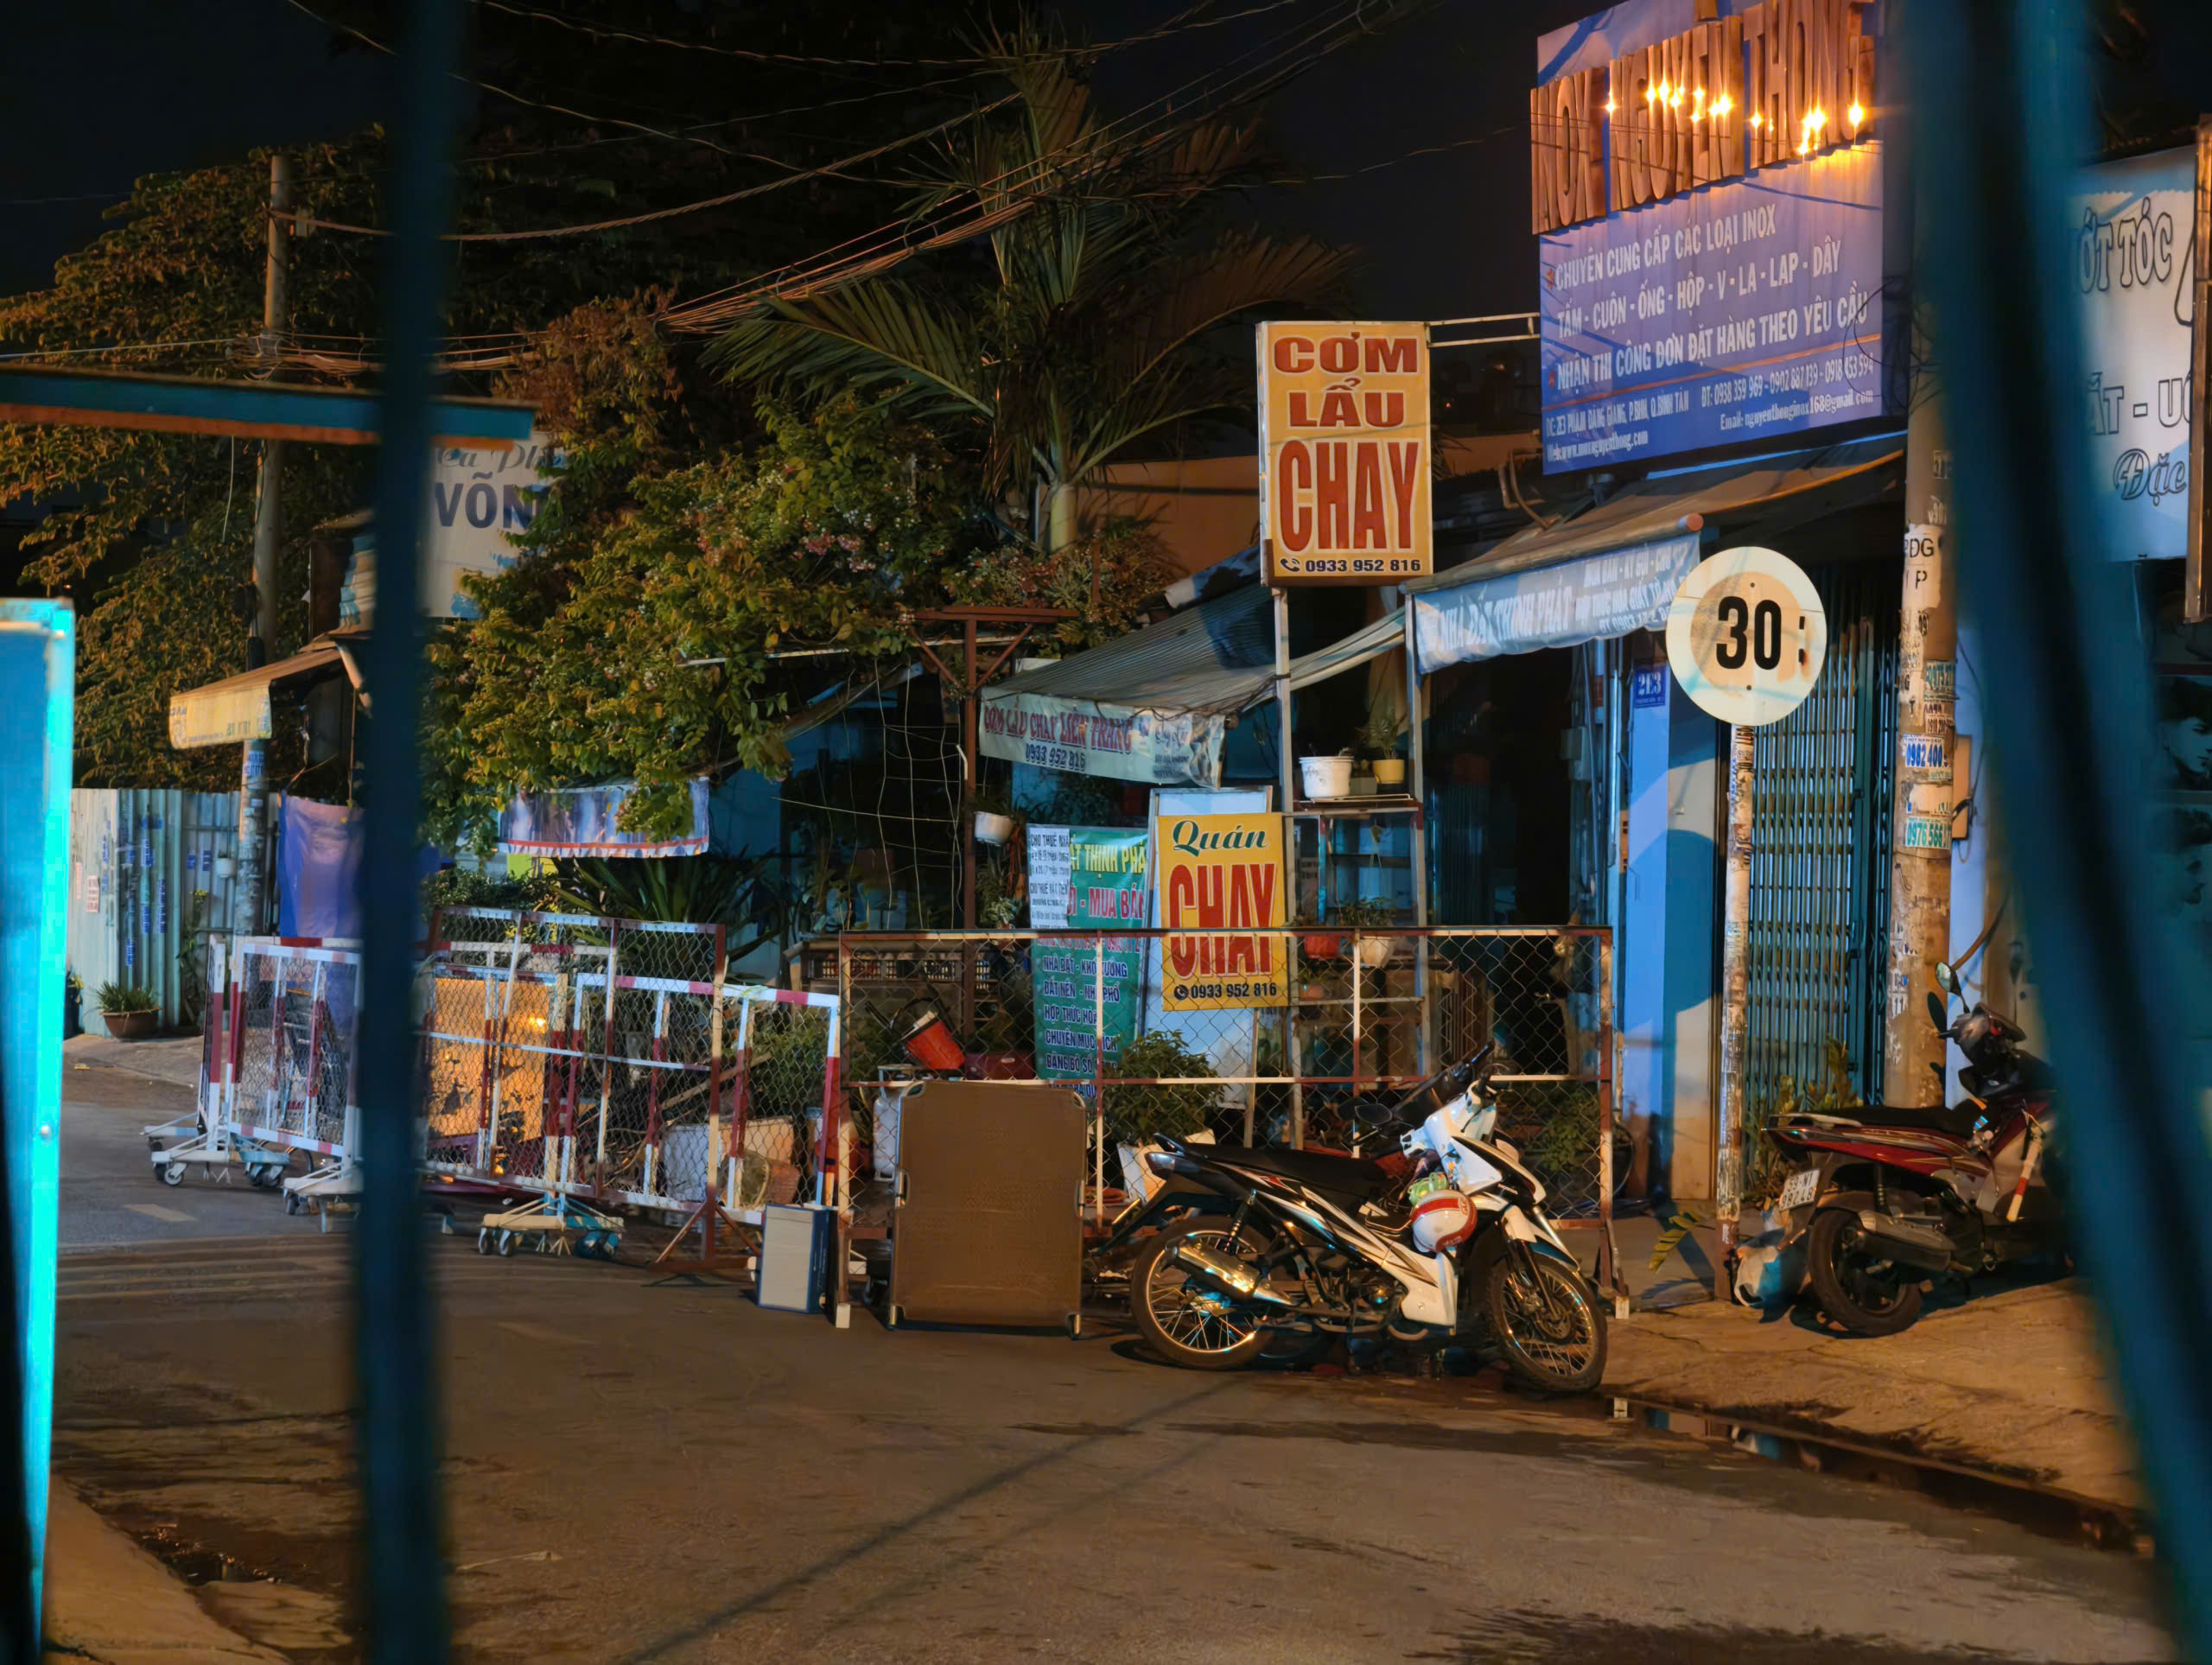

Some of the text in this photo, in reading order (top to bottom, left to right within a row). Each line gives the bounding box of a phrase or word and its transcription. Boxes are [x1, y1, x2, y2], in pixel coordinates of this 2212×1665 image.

[1556, 203, 1776, 291] CHUYÊN CUNG CẤP CÁC LOẠI INOX
[2117, 195, 2173, 289] TÓC
[1557, 298, 1583, 340] TẤM
[1592, 290, 1627, 334] CUỘN
[1638, 279, 1665, 320] ỐNG
[1677, 270, 1704, 316] HỘP
[1738, 262, 1758, 297] LA
[1770, 251, 1799, 288] LAP
[1813, 234, 1842, 278] DÂY
[1274, 332, 1419, 374] CƠM
[1557, 353, 1590, 395] NHẬN
[1592, 352, 1612, 383] THI
[1616, 339, 1652, 378] CÔNG
[1688, 323, 1714, 367] ĐẶT
[1717, 315, 1756, 354] HÀNG
[1758, 308, 1798, 346] THEO
[1803, 295, 1833, 337] YÊU
[1733, 378, 1747, 401] 359
[1748, 374, 1764, 398] 969
[1791, 365, 1805, 389] 887
[1288, 377, 1405, 428] LẨU
[1279, 439, 1420, 552] CHAY
[1305, 558, 1421, 573] 0933 952 816
[1715, 595, 1782, 670] 30
[1029, 711, 1058, 745] CHAY
[1026, 743, 1087, 772] 0933 952 816
[1172, 820, 1269, 857] Quán
[1088, 887, 1118, 918] MUA
[1168, 863, 1277, 980] CHAY
[1190, 982, 1277, 1000] 0933 952 816
